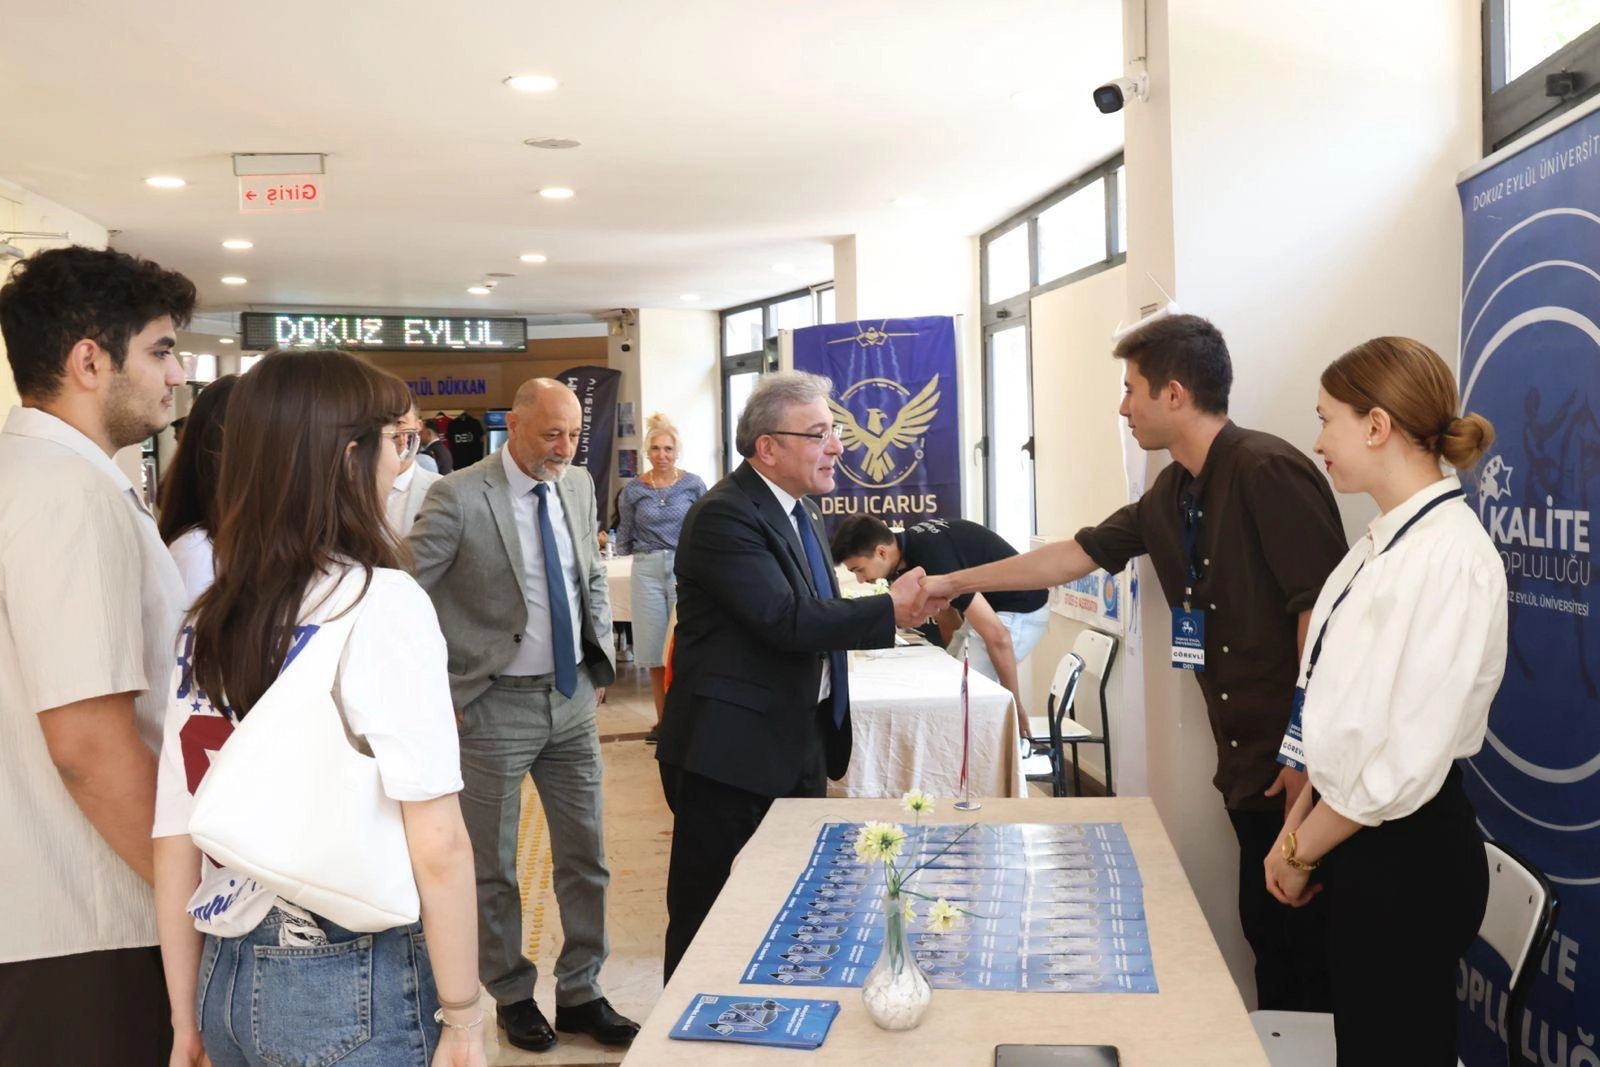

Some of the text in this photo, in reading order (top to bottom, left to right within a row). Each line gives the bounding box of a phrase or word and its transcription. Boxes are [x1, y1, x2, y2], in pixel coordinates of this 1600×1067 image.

[1472, 134, 1600, 212] DOKUZ EYLÜL ÜNİVERSİT
[275, 316, 503, 345] DOKUZ EYLÜL
[406, 376, 487, 396] YLÜL DÜKKAN
[821, 494, 938, 515] DEU ICARUS
[1489, 494, 1591, 553] KALİTE
[1499, 550, 1591, 586] OPLULUĞU
[1539, 593, 1590, 617] ÜNİVERSİTESİ
